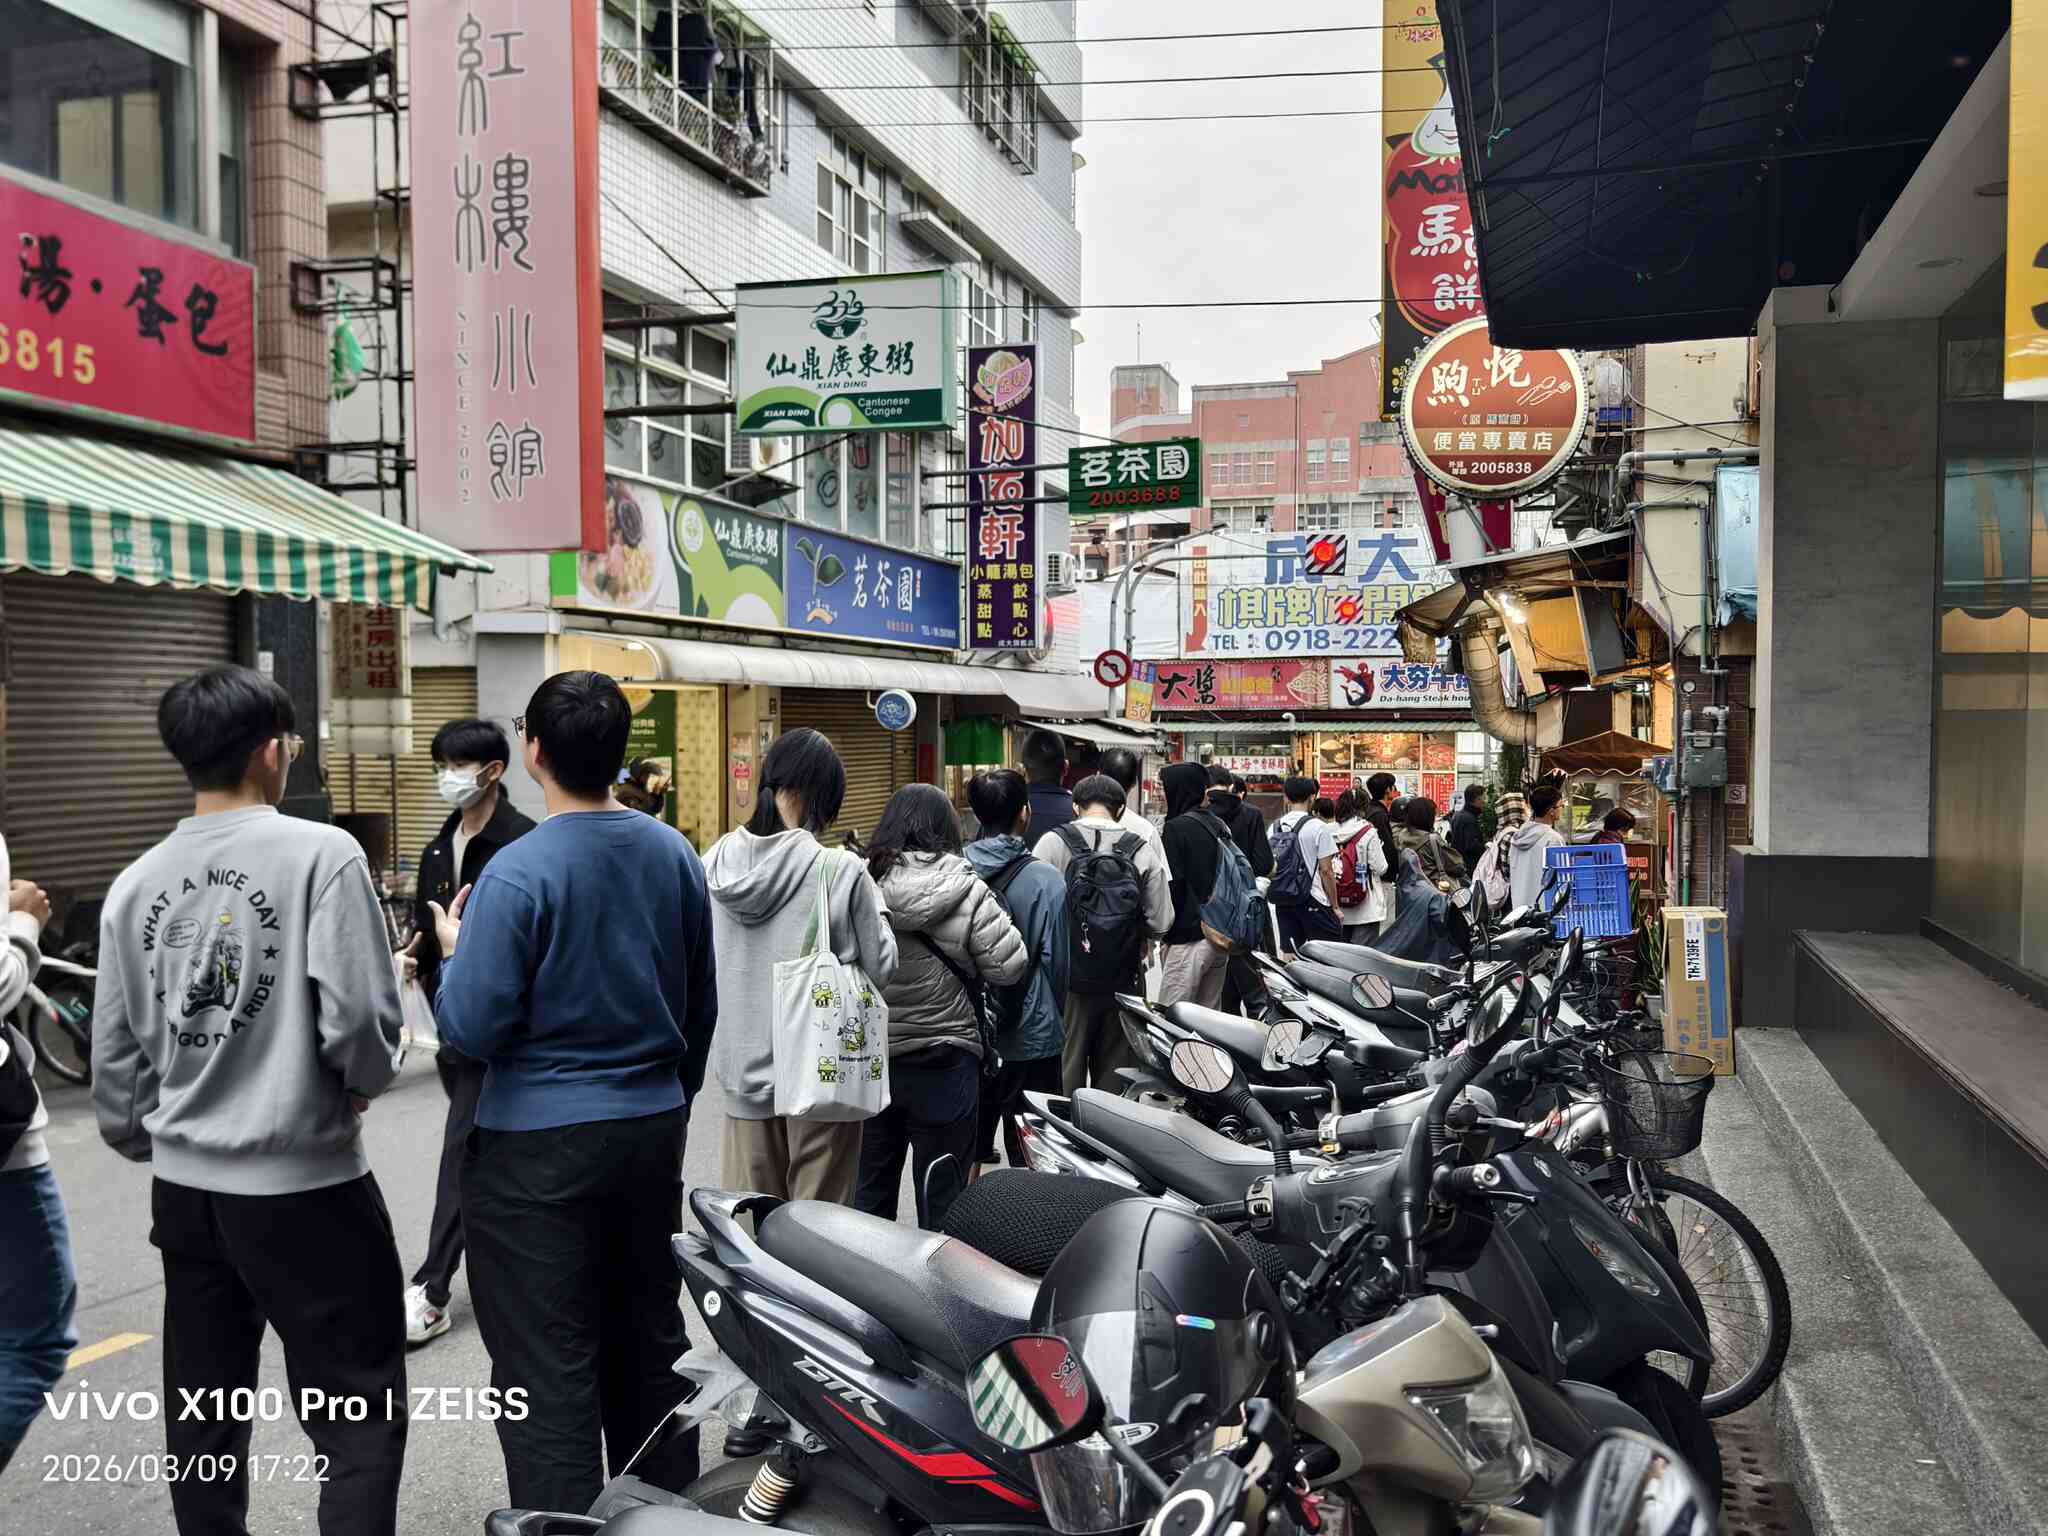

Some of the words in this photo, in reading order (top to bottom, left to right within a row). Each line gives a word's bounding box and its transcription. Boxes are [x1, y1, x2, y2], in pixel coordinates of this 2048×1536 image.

[766, 341, 914, 381] 仙鼎廣東粥
[858, 397, 911, 407] Cantonese
[864, 407, 903, 418] Congee
[1433, 431, 1553, 451] 便當專賣店
[1079, 445, 1190, 487] 茗茶園
[1471, 462, 1532, 474] 2005838
[143, 890, 172, 952] WHAT
[182, 877, 197, 895] A
[207, 869, 249, 891] NICE
[248, 889, 281, 932] DAY
[178, 1032, 209, 1048] GO
[242, 973, 276, 1020] RIDE
